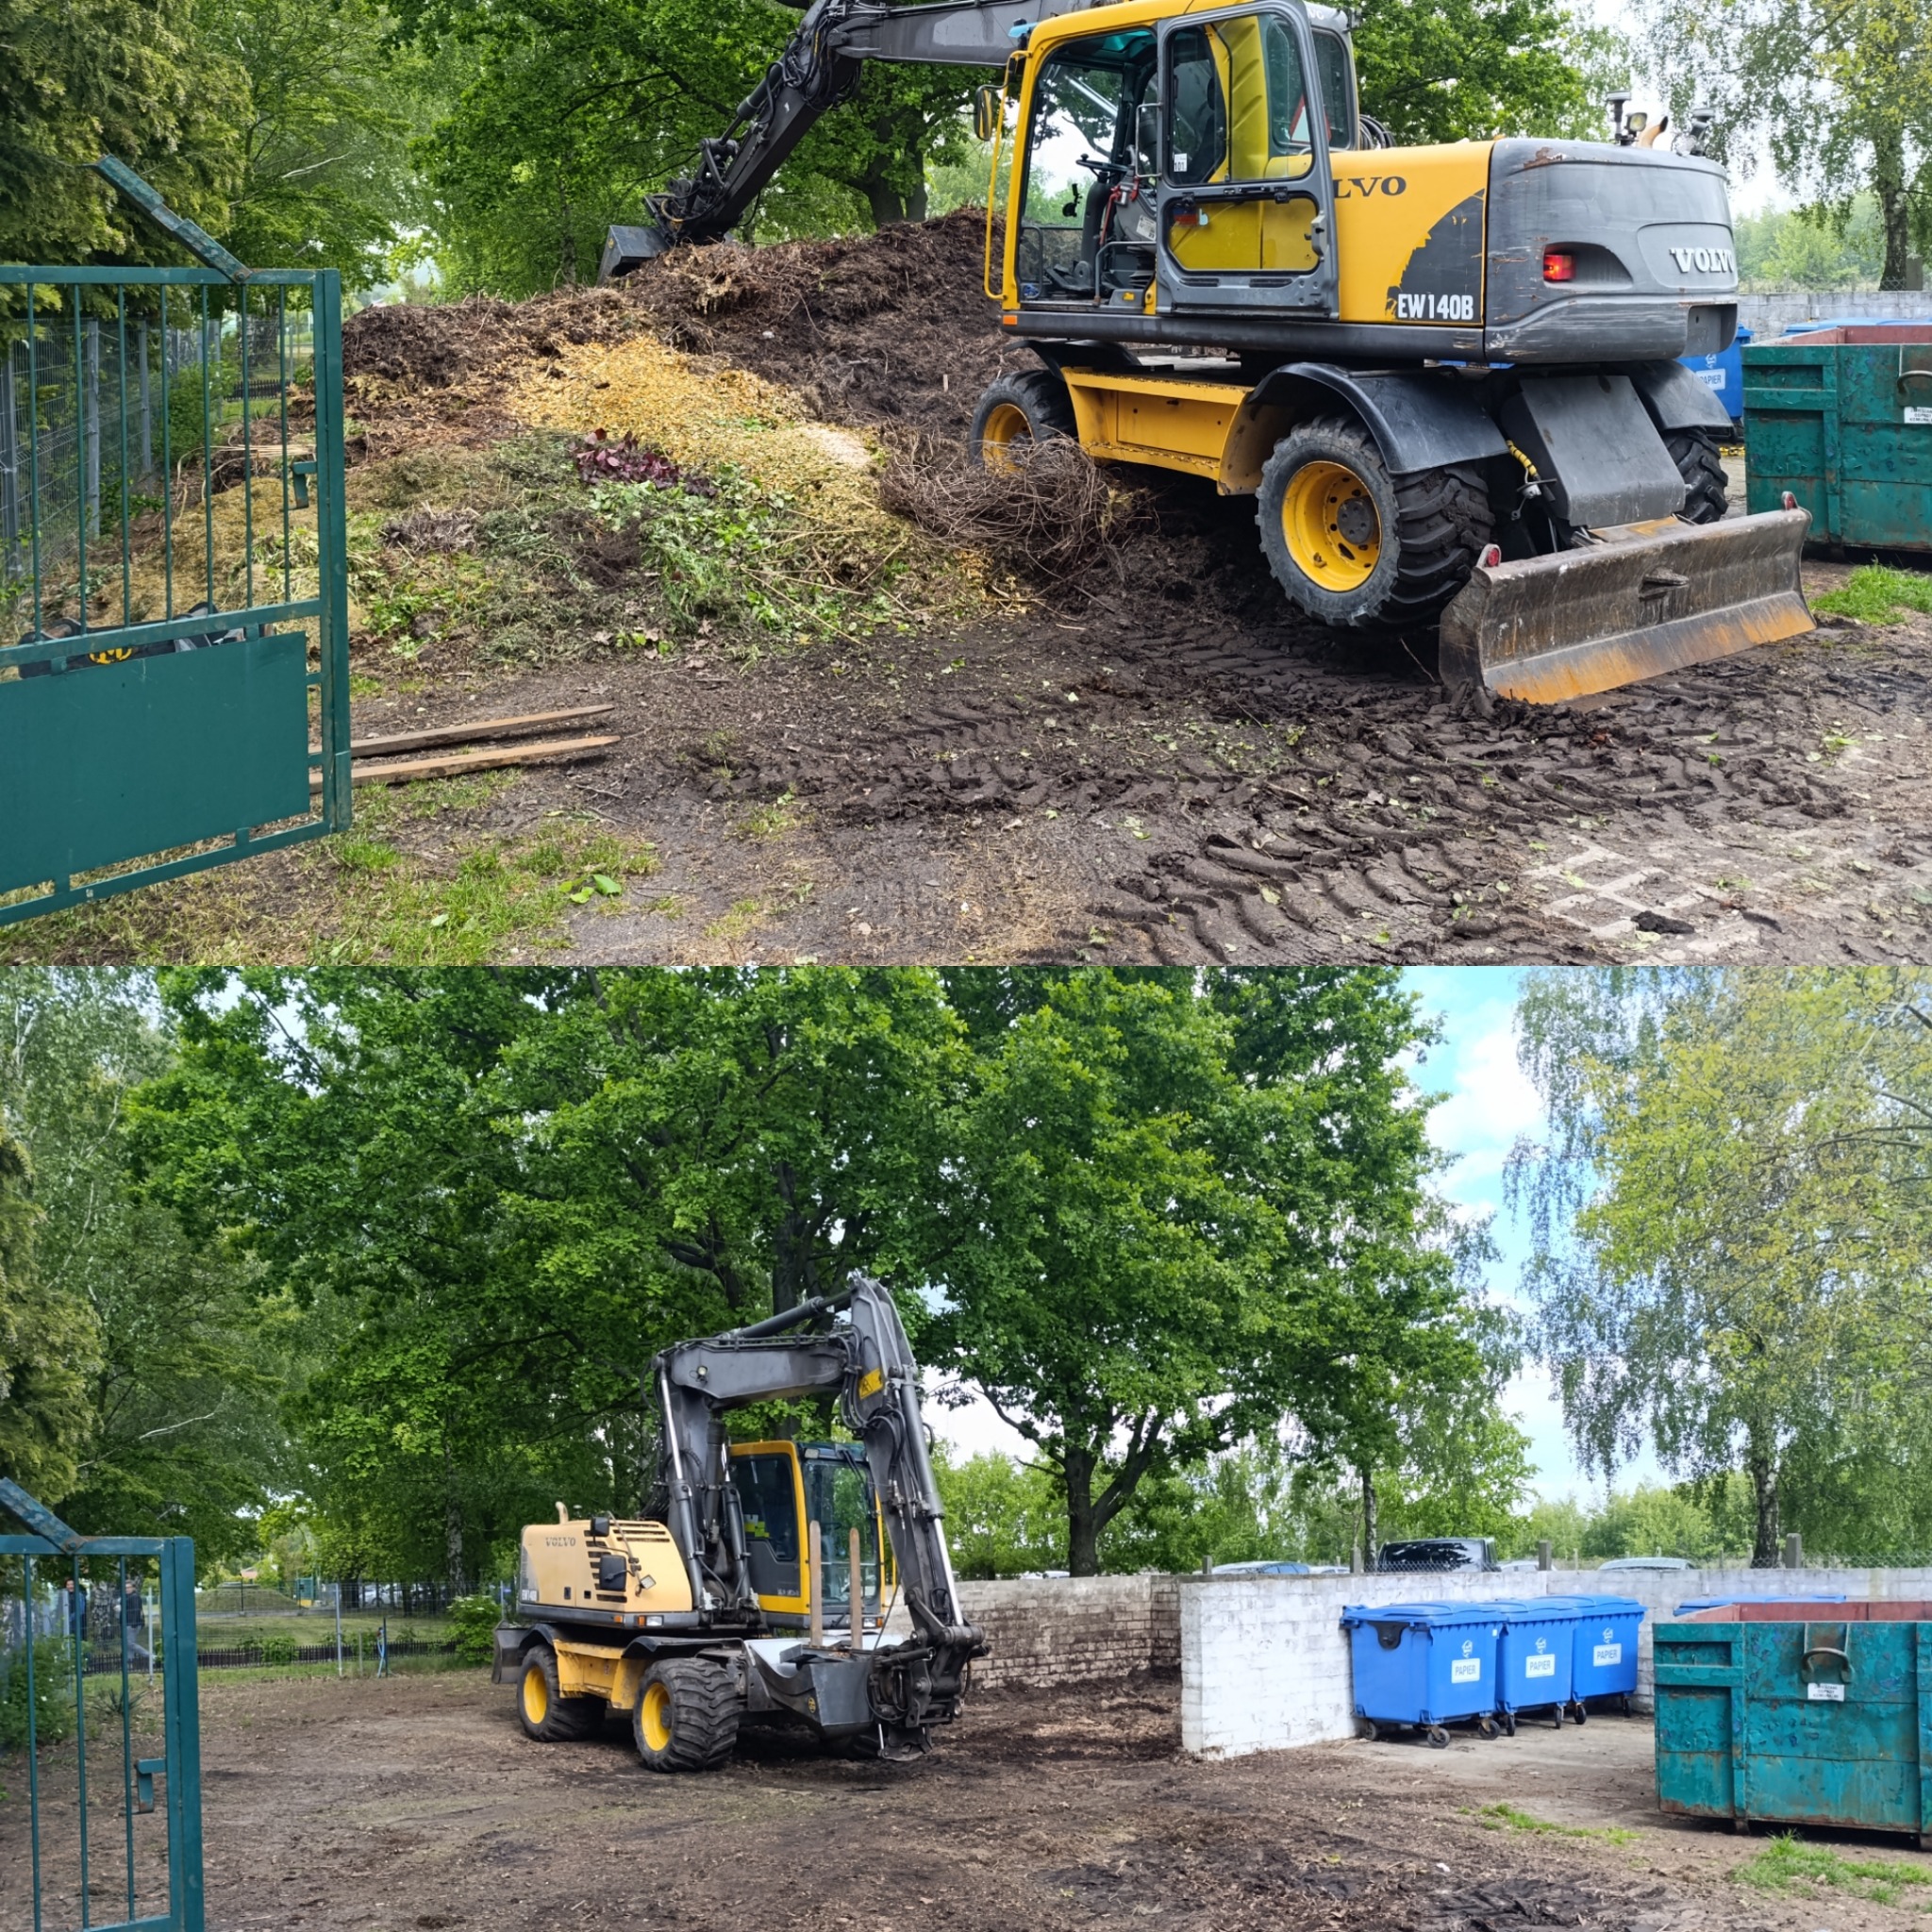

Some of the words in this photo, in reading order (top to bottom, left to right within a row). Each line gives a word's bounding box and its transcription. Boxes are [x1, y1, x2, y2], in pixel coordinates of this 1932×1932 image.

[1332, 175, 1407, 199] LVO
[1398, 293, 1474, 320] EW140B
[545, 1537, 576, 1547] VOLVO
[1596, 1649, 1618, 1660] PAPIER
[1455, 1665, 1476, 1676] PAPIER
[1529, 1660, 1551, 1671] PAPIER
